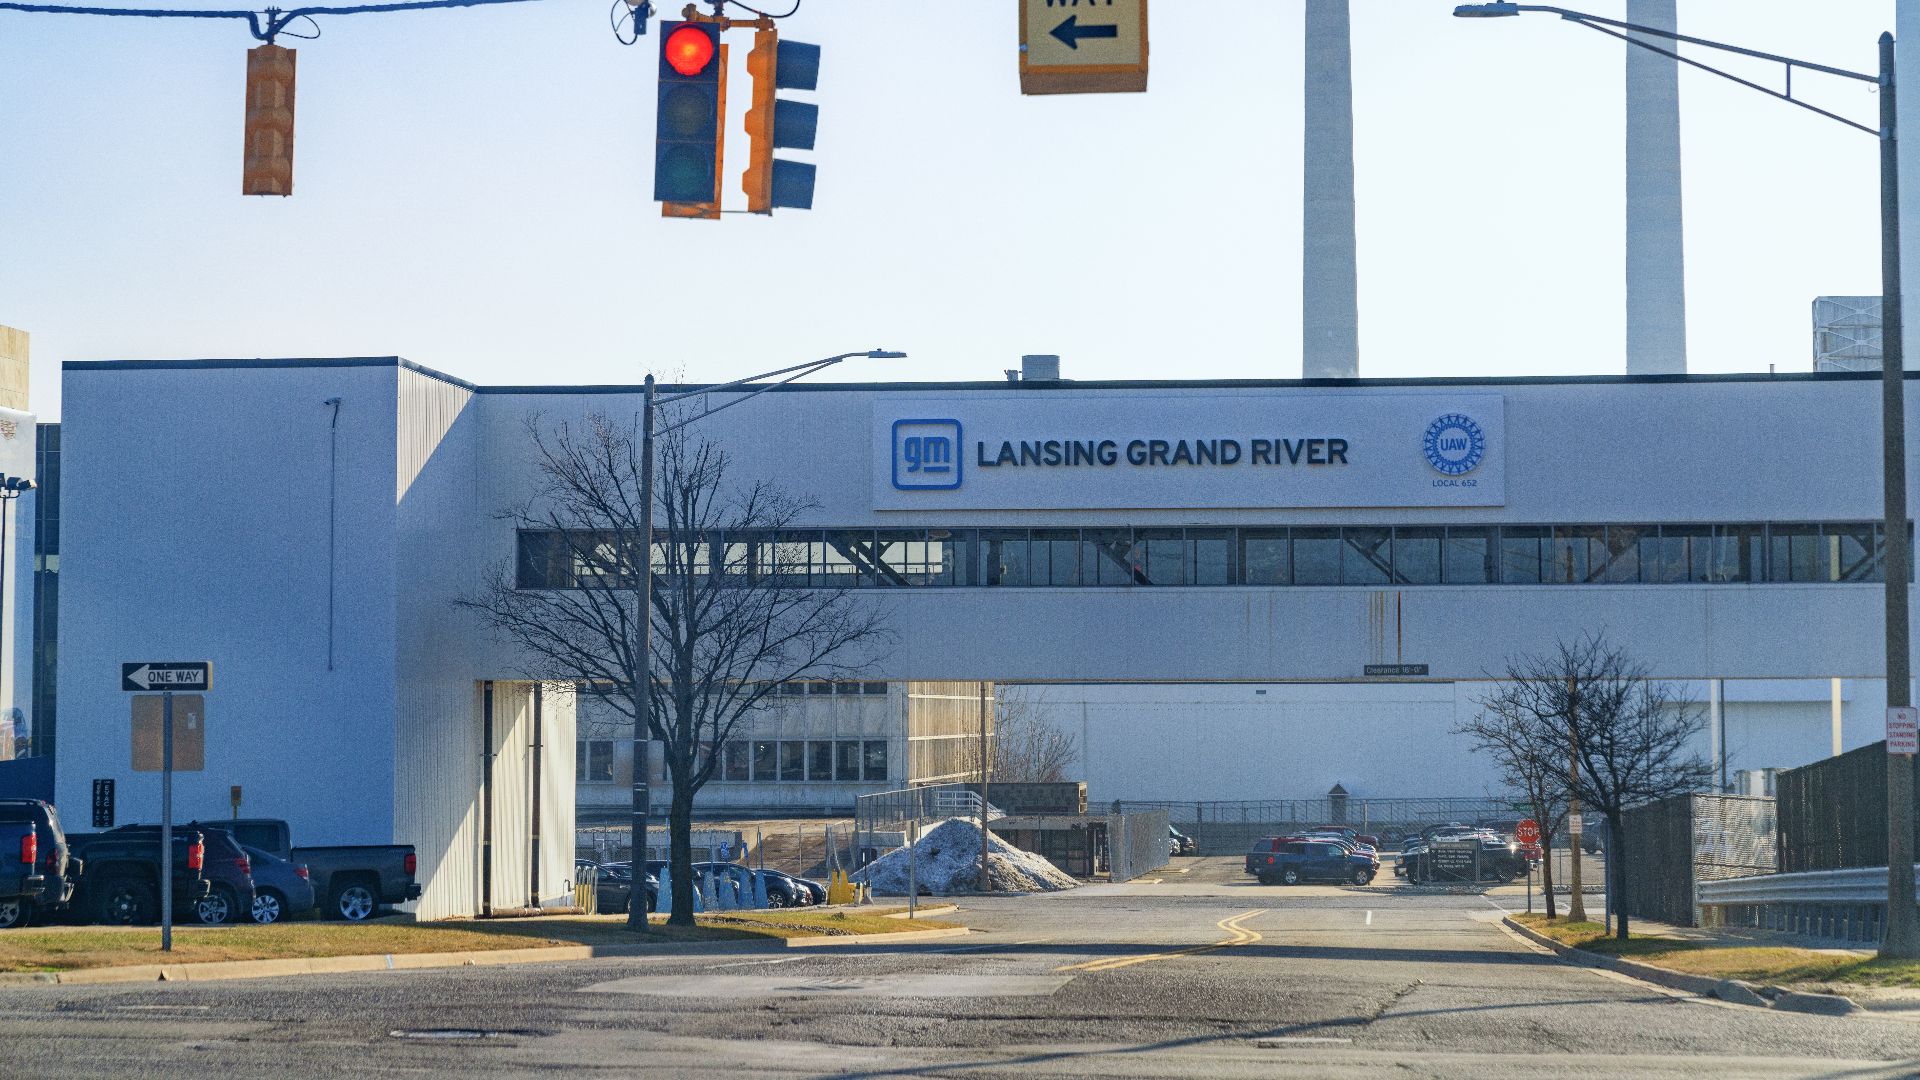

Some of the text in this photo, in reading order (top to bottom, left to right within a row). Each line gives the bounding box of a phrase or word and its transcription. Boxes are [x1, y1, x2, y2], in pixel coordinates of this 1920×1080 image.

[1440, 438, 1467, 451] UAW
[904, 436, 950, 473] gm
[977, 438, 1349, 467] LANSING GRAND RIVER
[148, 671, 200, 682] ONE WAY
[1517, 826, 1540, 836] STOP
